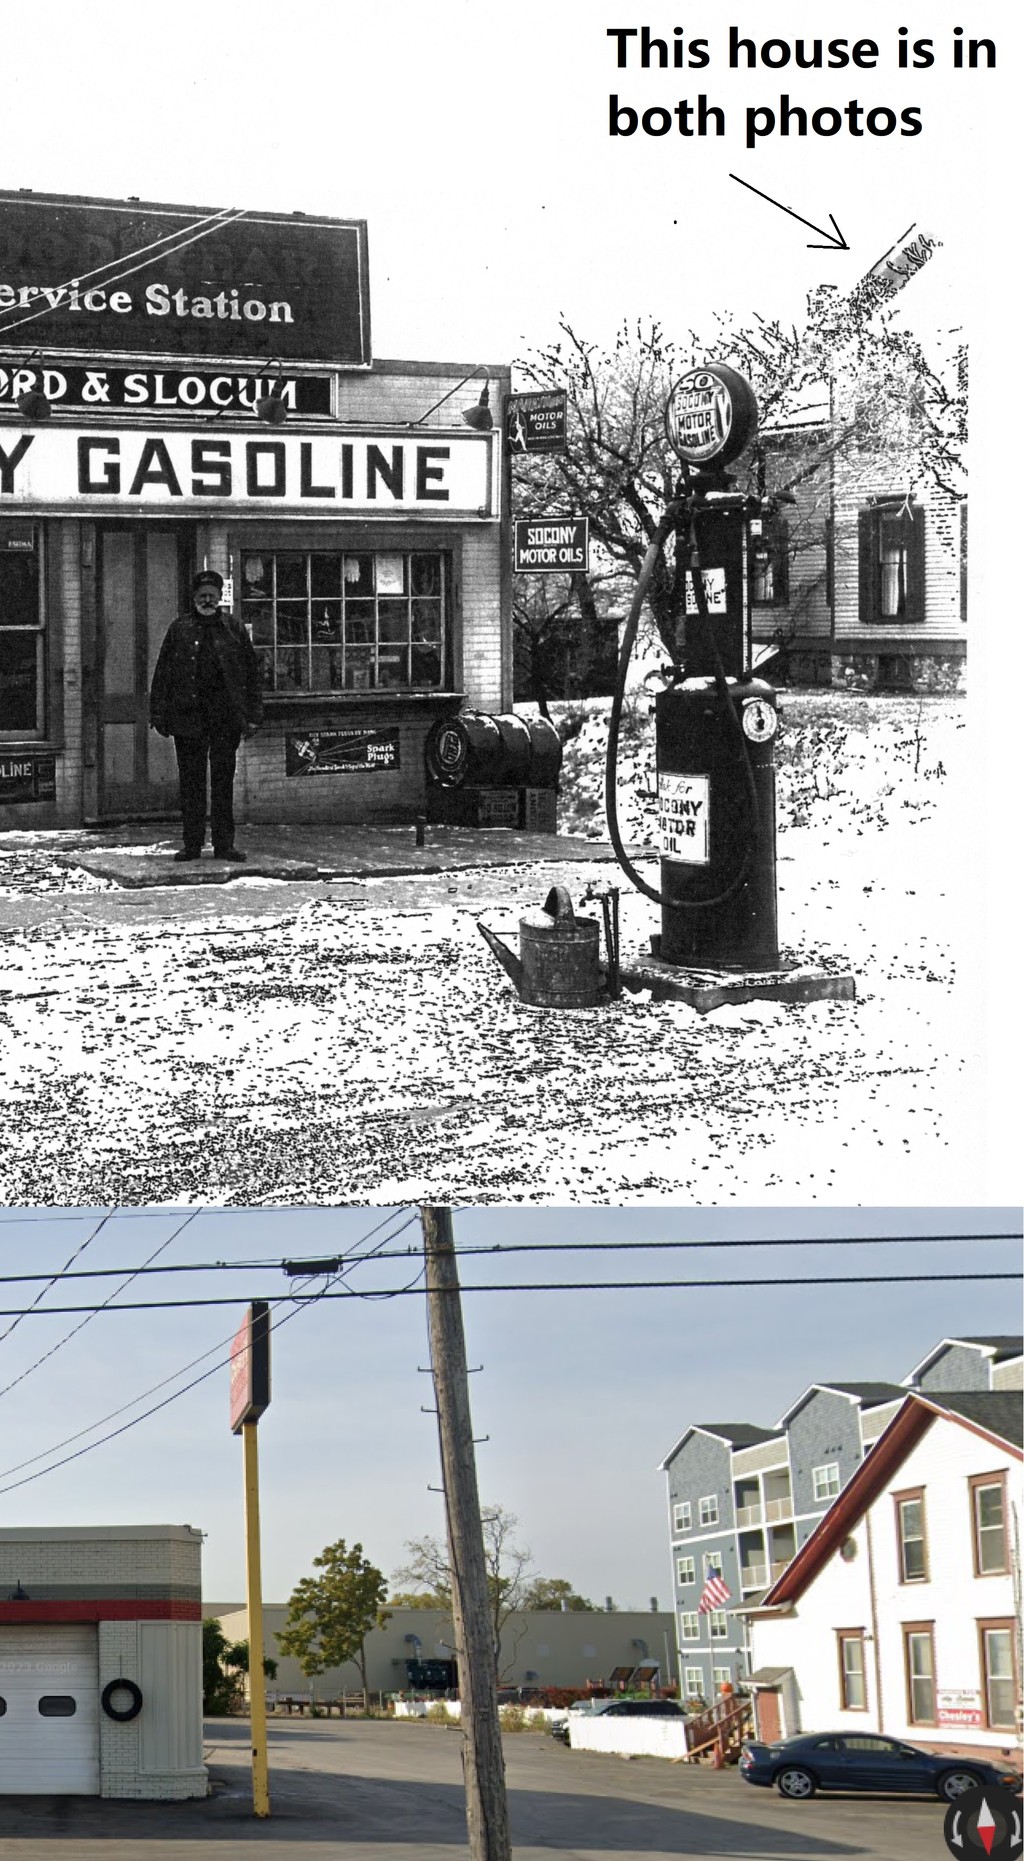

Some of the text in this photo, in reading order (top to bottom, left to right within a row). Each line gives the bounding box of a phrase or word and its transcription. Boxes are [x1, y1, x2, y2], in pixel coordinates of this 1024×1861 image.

[145, 283, 295, 324] Station
[81, 372, 111, 402] &
[677, 391, 714, 411] SOCONY
[529, 411, 564, 422] MOTOR
[534, 421, 558, 431] OILS
[678, 411, 711, 431] MOTOR
[77, 436, 451, 501] GASOLINE
[527, 526, 577, 545] SOCONY
[519, 547, 584, 564] MOTOR OILS
[366, 743, 395, 754] Spark
[367, 752, 395, 765] Plugs
[663, 836, 682, 855] OIL
